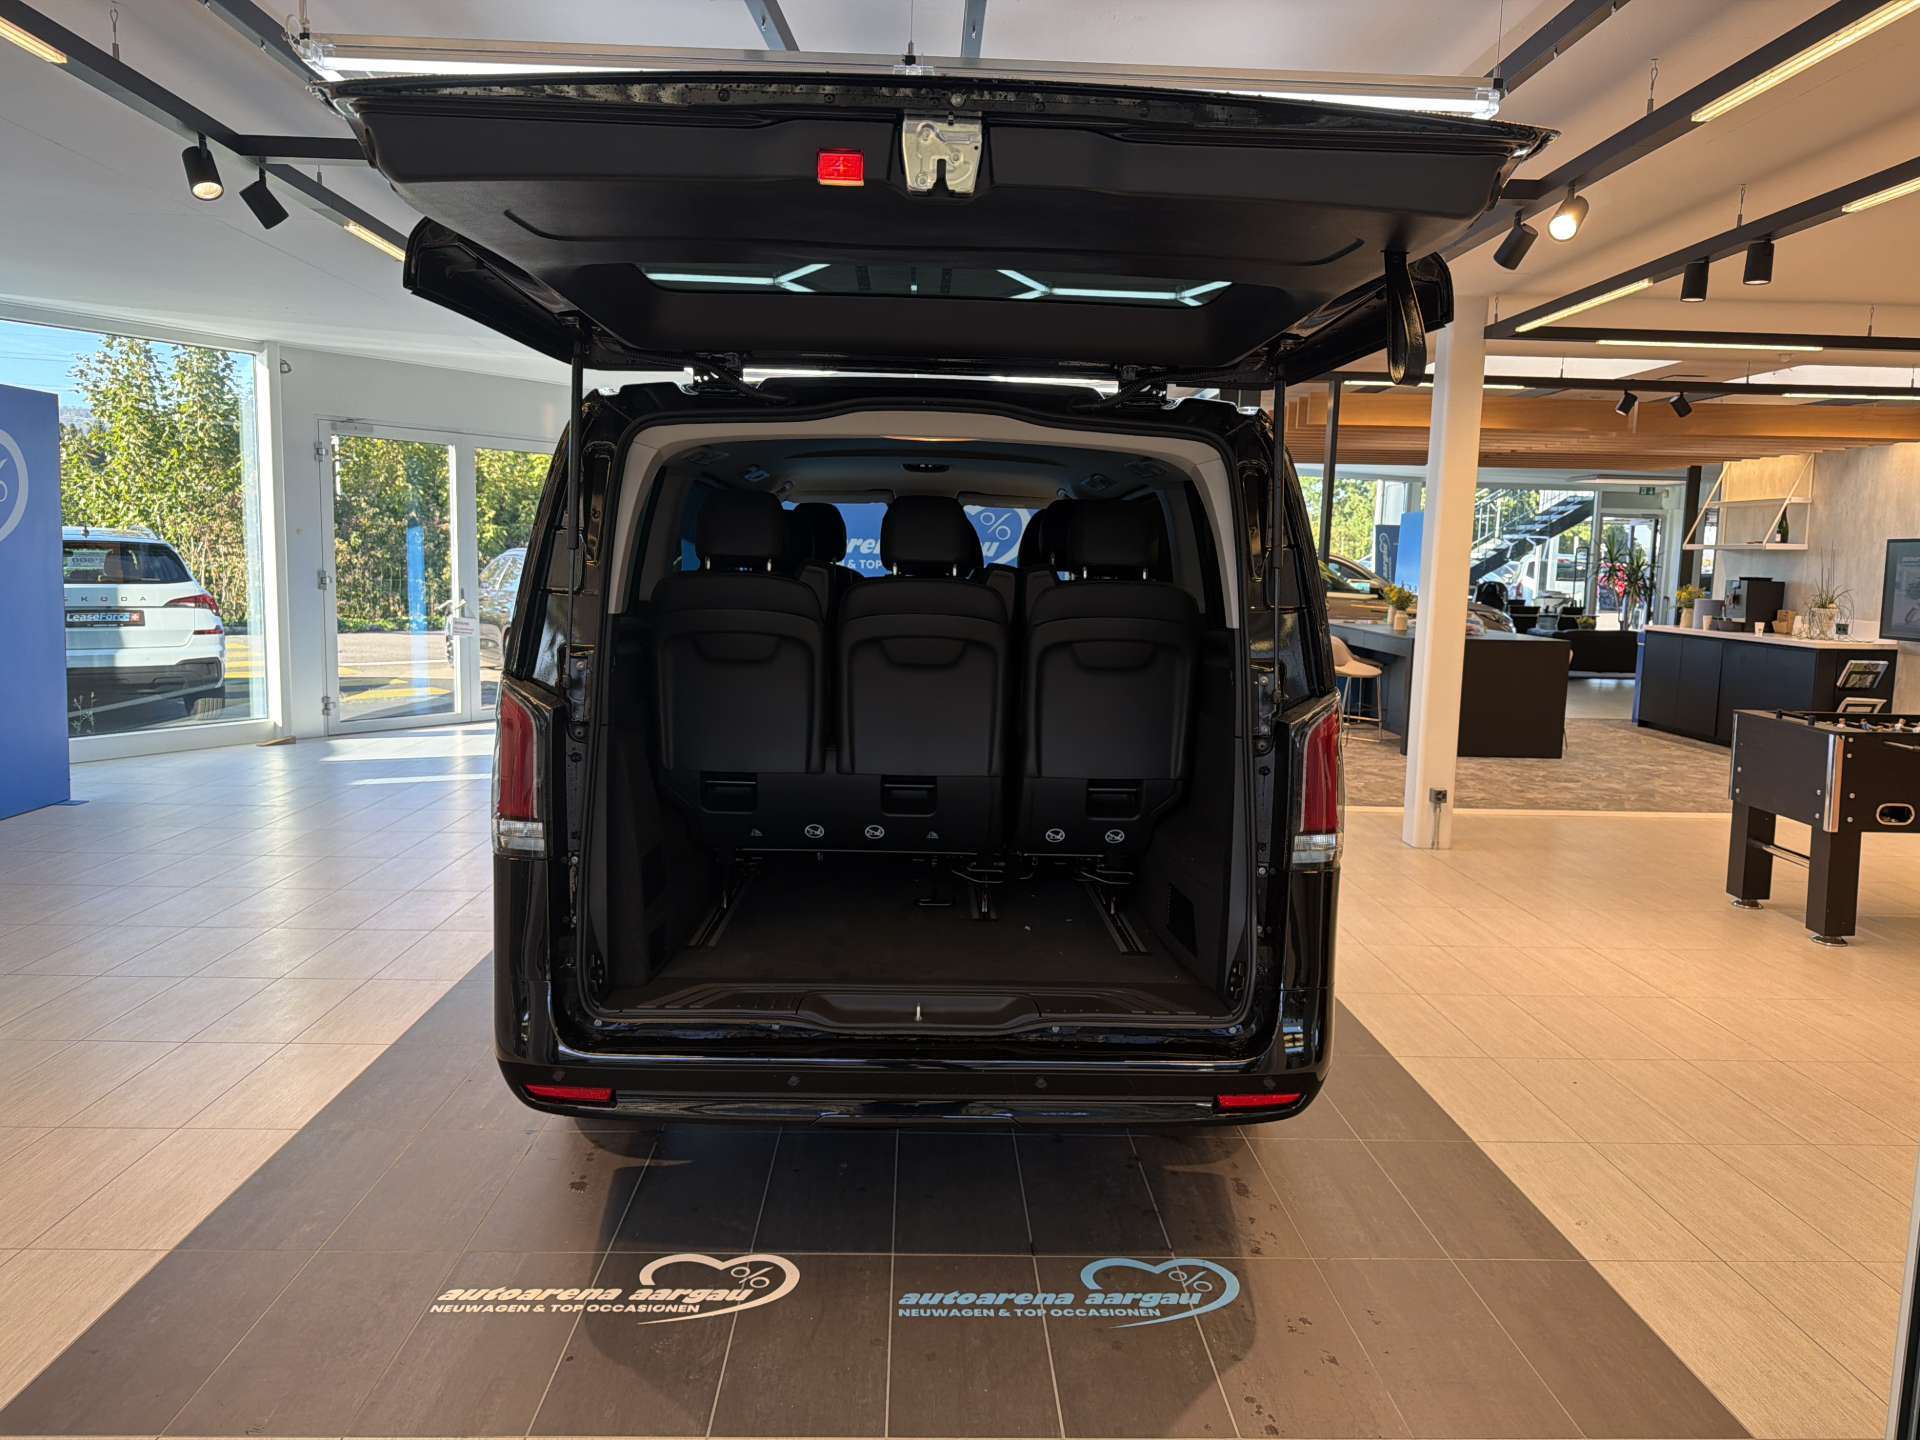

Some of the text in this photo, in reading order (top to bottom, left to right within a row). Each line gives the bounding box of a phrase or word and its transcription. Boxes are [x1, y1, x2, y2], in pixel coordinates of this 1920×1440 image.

[437, 1286, 754, 1304] autoarena aargau
[898, 1290, 1203, 1307] autoarena aargau
[430, 1304, 700, 1313] NEUWAGEN & TOP OCCASIONEN
[898, 1308, 1161, 1317] NEUWAGEN & TOP OCCASIONEN
